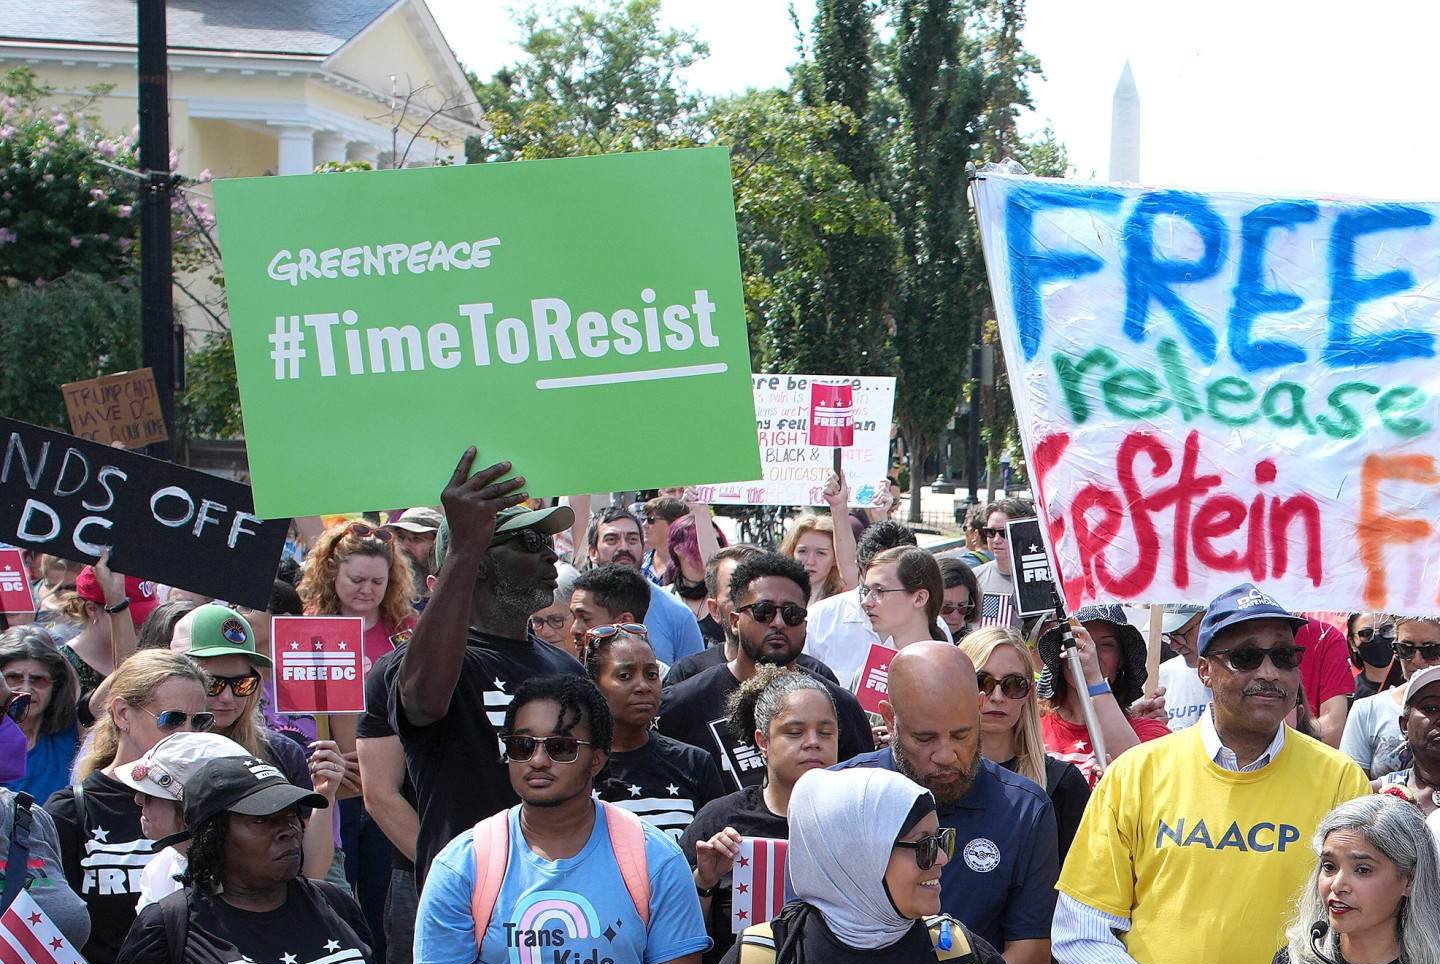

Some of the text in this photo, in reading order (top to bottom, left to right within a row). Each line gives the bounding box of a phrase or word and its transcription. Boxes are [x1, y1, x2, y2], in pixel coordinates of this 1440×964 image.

[267, 237, 501, 286] GREENPEACE
[1005, 186, 1436, 371] FREE
[268, 288, 720, 380] #TimeToResist
[68, 383, 121, 408] TRUMP
[752, 377, 780, 390] ere
[1052, 337, 1436, 439] release
[71, 396, 155, 428] HAVE DC
[776, 418, 807, 431] fell
[814, 417, 845, 427] FREE
[766, 448, 806, 463] BLACK
[17, 498, 114, 558] DC
[150, 485, 263, 550] OFF
[1023, 568, 1050, 583] FR
[282, 666, 356, 681] FREE DC
[865, 679, 889, 694] FR
[1168, 703, 1206, 720] SUPP
[738, 755, 767, 772] FR
[1155, 817, 1300, 852] NAACP
[81, 868, 144, 896] FRE
[503, 922, 564, 948] Trans
